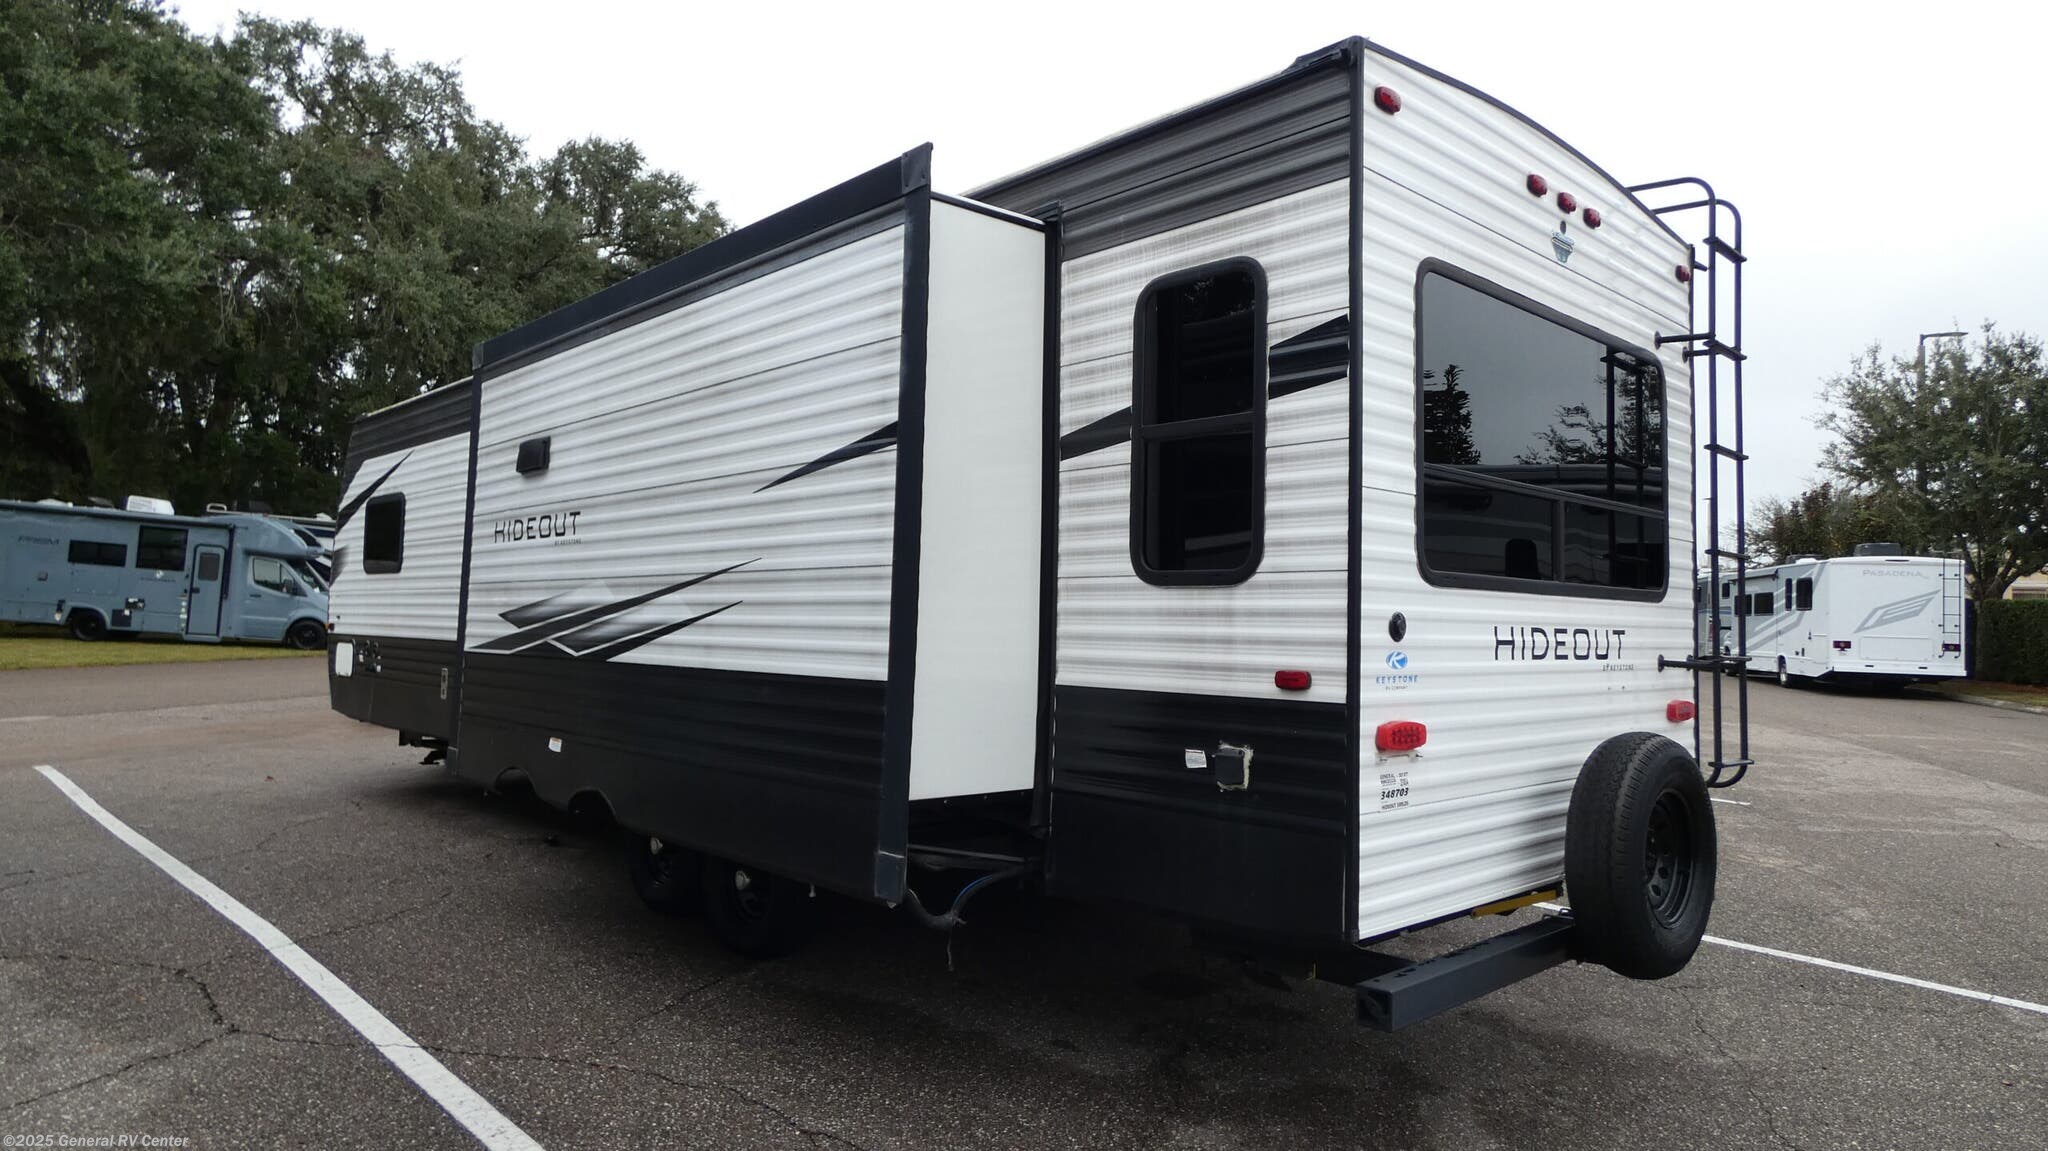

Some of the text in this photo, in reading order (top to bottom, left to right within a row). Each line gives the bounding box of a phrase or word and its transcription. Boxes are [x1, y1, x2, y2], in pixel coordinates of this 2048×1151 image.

[494, 511, 581, 543] HIDEOUT
[1494, 626, 1626, 661] HIDEOUT
[1376, 675, 1418, 684] KEYSTONE
[1381, 787, 1409, 800] 348703
